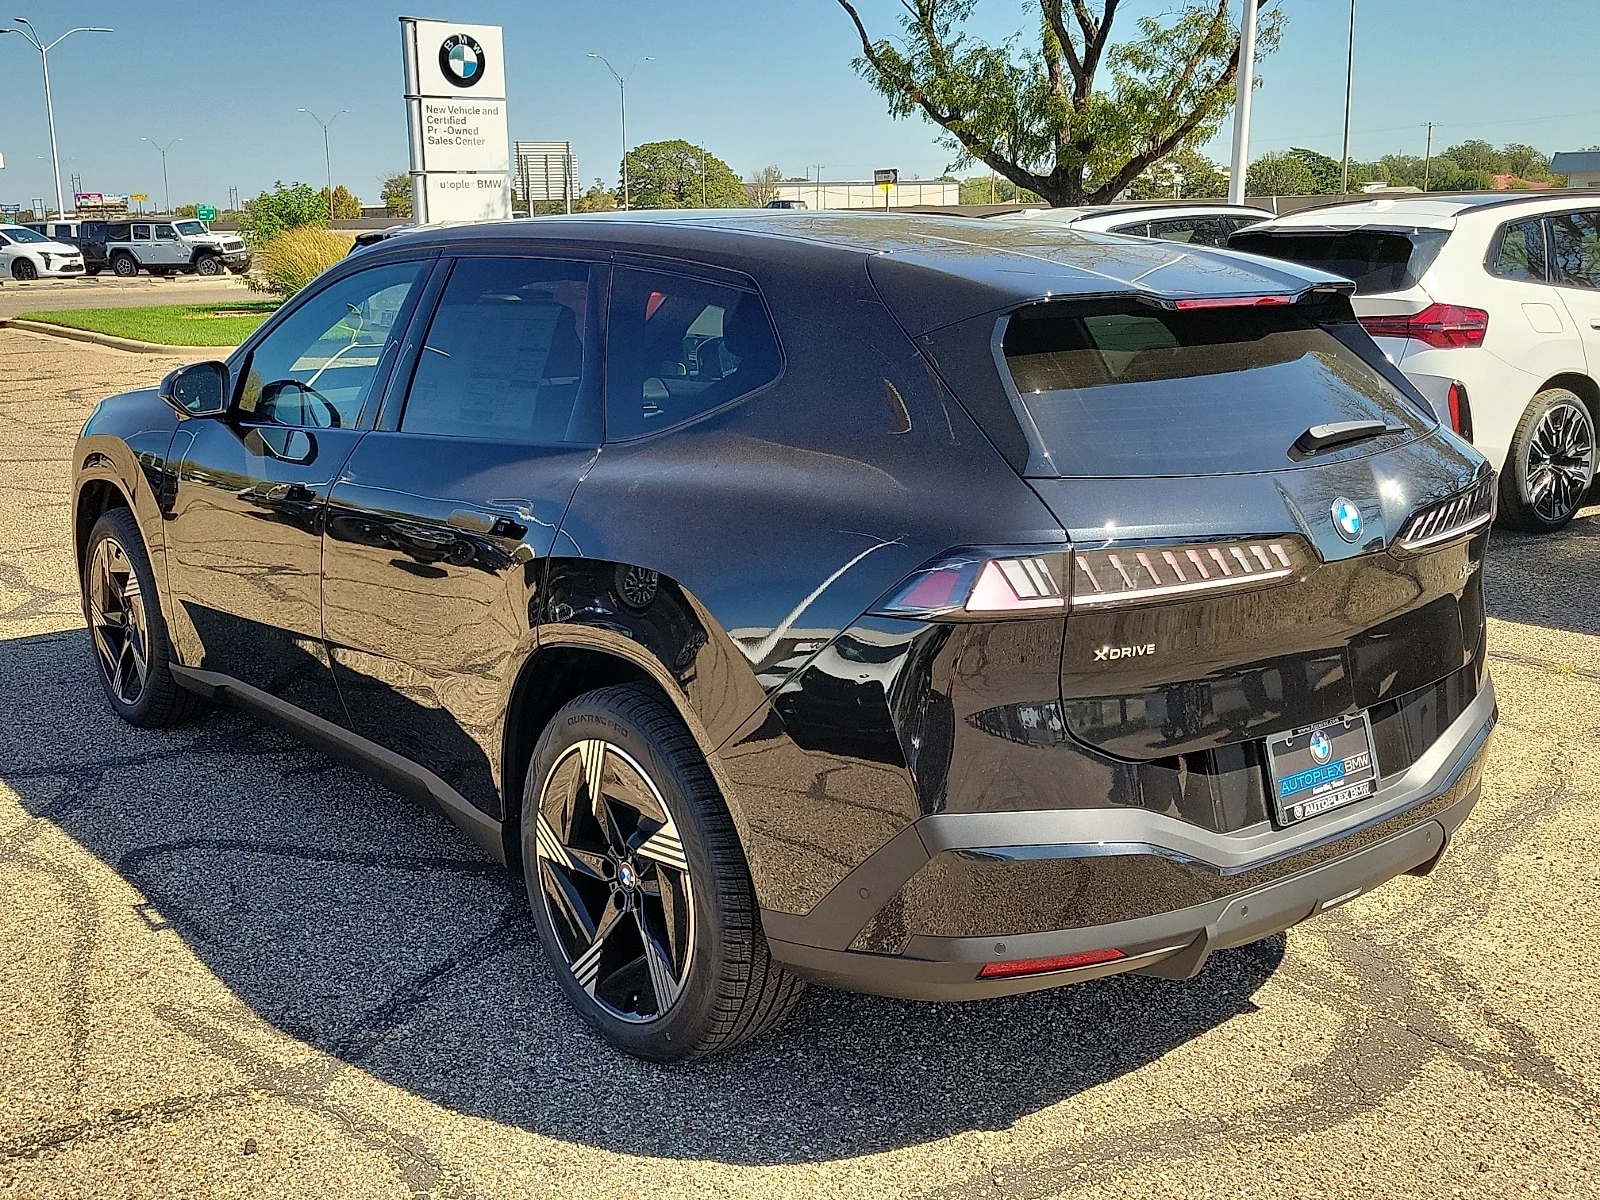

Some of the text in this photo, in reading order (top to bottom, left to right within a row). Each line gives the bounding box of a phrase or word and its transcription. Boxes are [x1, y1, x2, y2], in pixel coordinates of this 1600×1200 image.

[443, 34, 482, 54] BMW
[425, 104, 499, 116] New Vehicle and
[426, 115, 467, 125] Certified
[427, 125, 479, 136] Pr-Owned
[427, 136, 486, 146] Sales Center
[434, 179, 502, 191] utople BMW
[567, 714, 606, 727] QUATRAC
[1280, 754, 1370, 794] AUTOPLEX BMW
[1304, 782, 1370, 816] AUTOPLEX BMW
